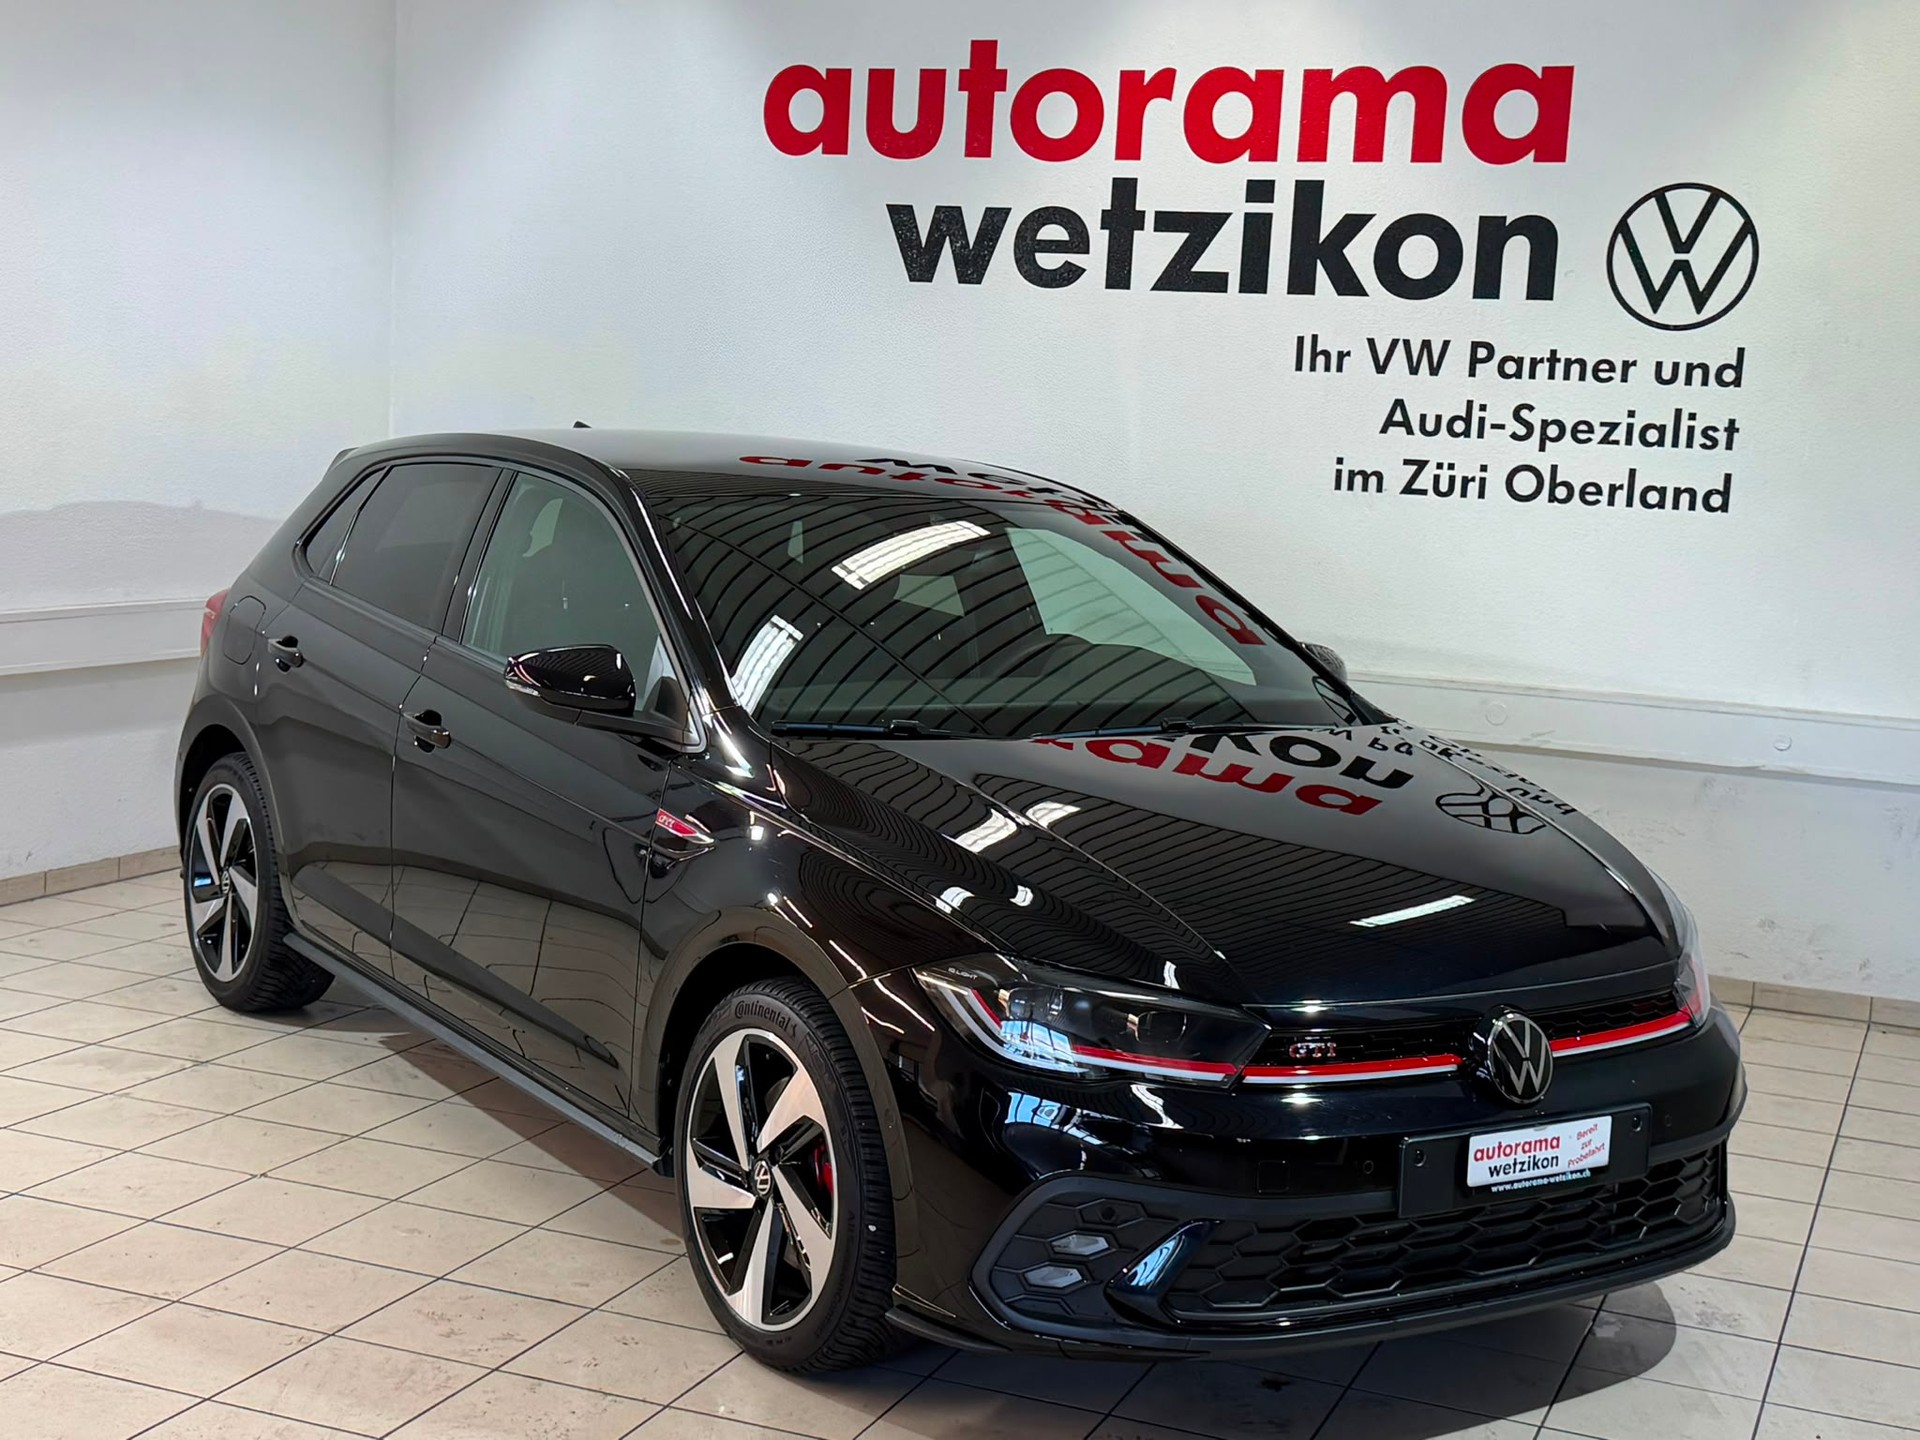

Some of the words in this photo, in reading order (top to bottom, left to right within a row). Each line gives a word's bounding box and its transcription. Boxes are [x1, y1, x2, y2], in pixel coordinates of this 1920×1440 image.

[763, 40, 1574, 166] autorama
[886, 178, 1559, 301] wetzikon
[1294, 333, 1352, 374] Ihr
[1366, 338, 1452, 377] VW
[1468, 340, 1638, 386] Partner
[1654, 347, 1746, 388] und
[1379, 398, 1741, 453] Audi-Spezialist
[1333, 458, 1385, 495] im
[1399, 458, 1489, 501] Züri
[1504, 464, 1733, 514] Oberland
[1288, 1041, 1337, 1059] GTI
[1473, 1135, 1561, 1163] autorama
[1488, 1154, 1560, 1178] wetzikon
